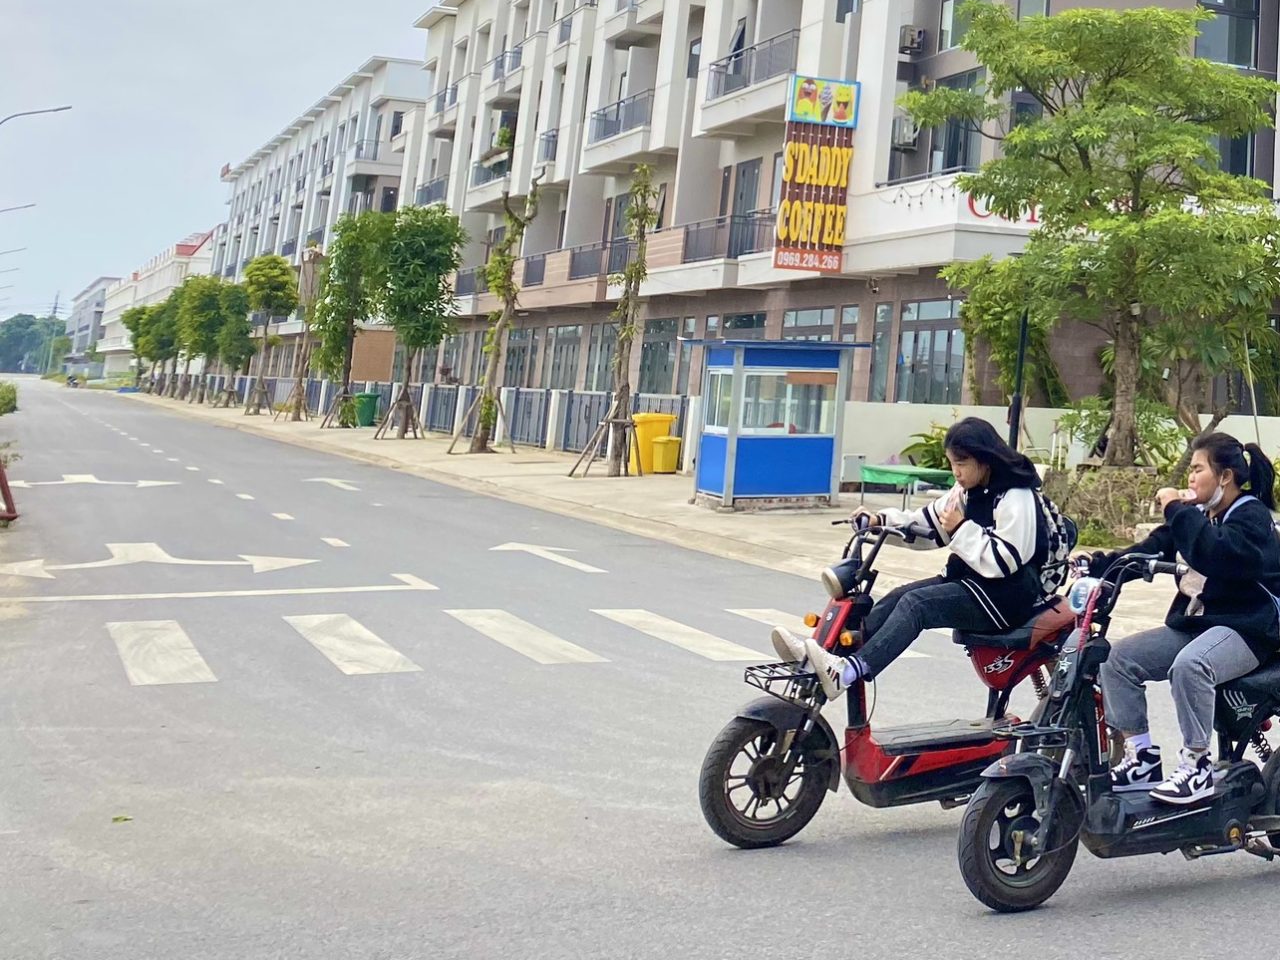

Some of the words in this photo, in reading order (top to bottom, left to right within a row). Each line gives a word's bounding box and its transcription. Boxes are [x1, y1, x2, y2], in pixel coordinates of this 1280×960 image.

[783, 141, 853, 188] S'DADDY
[777, 200, 847, 246] COFFEE
[777, 251, 839, 270] 0969.284.266
